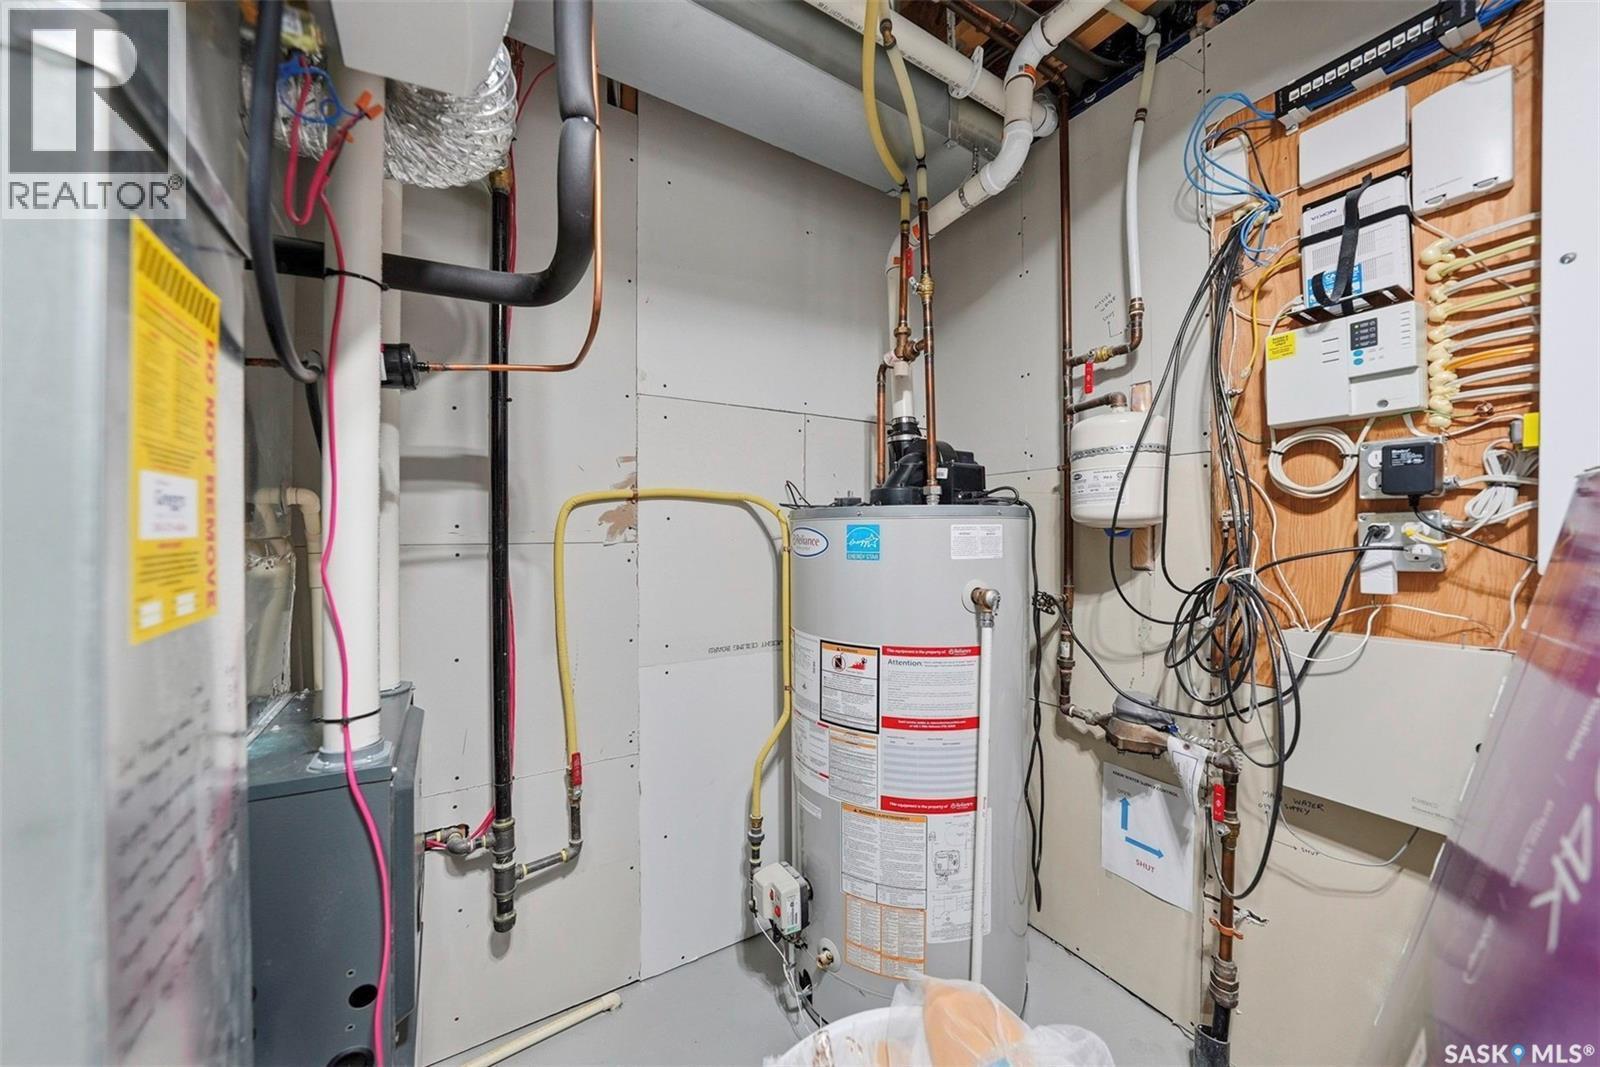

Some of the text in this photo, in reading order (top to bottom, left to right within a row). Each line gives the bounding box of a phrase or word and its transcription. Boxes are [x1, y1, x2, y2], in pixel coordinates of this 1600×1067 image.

[205, 338, 217, 610] DO NOT REMOVE
[1135, 858, 1155, 873] SHUT
